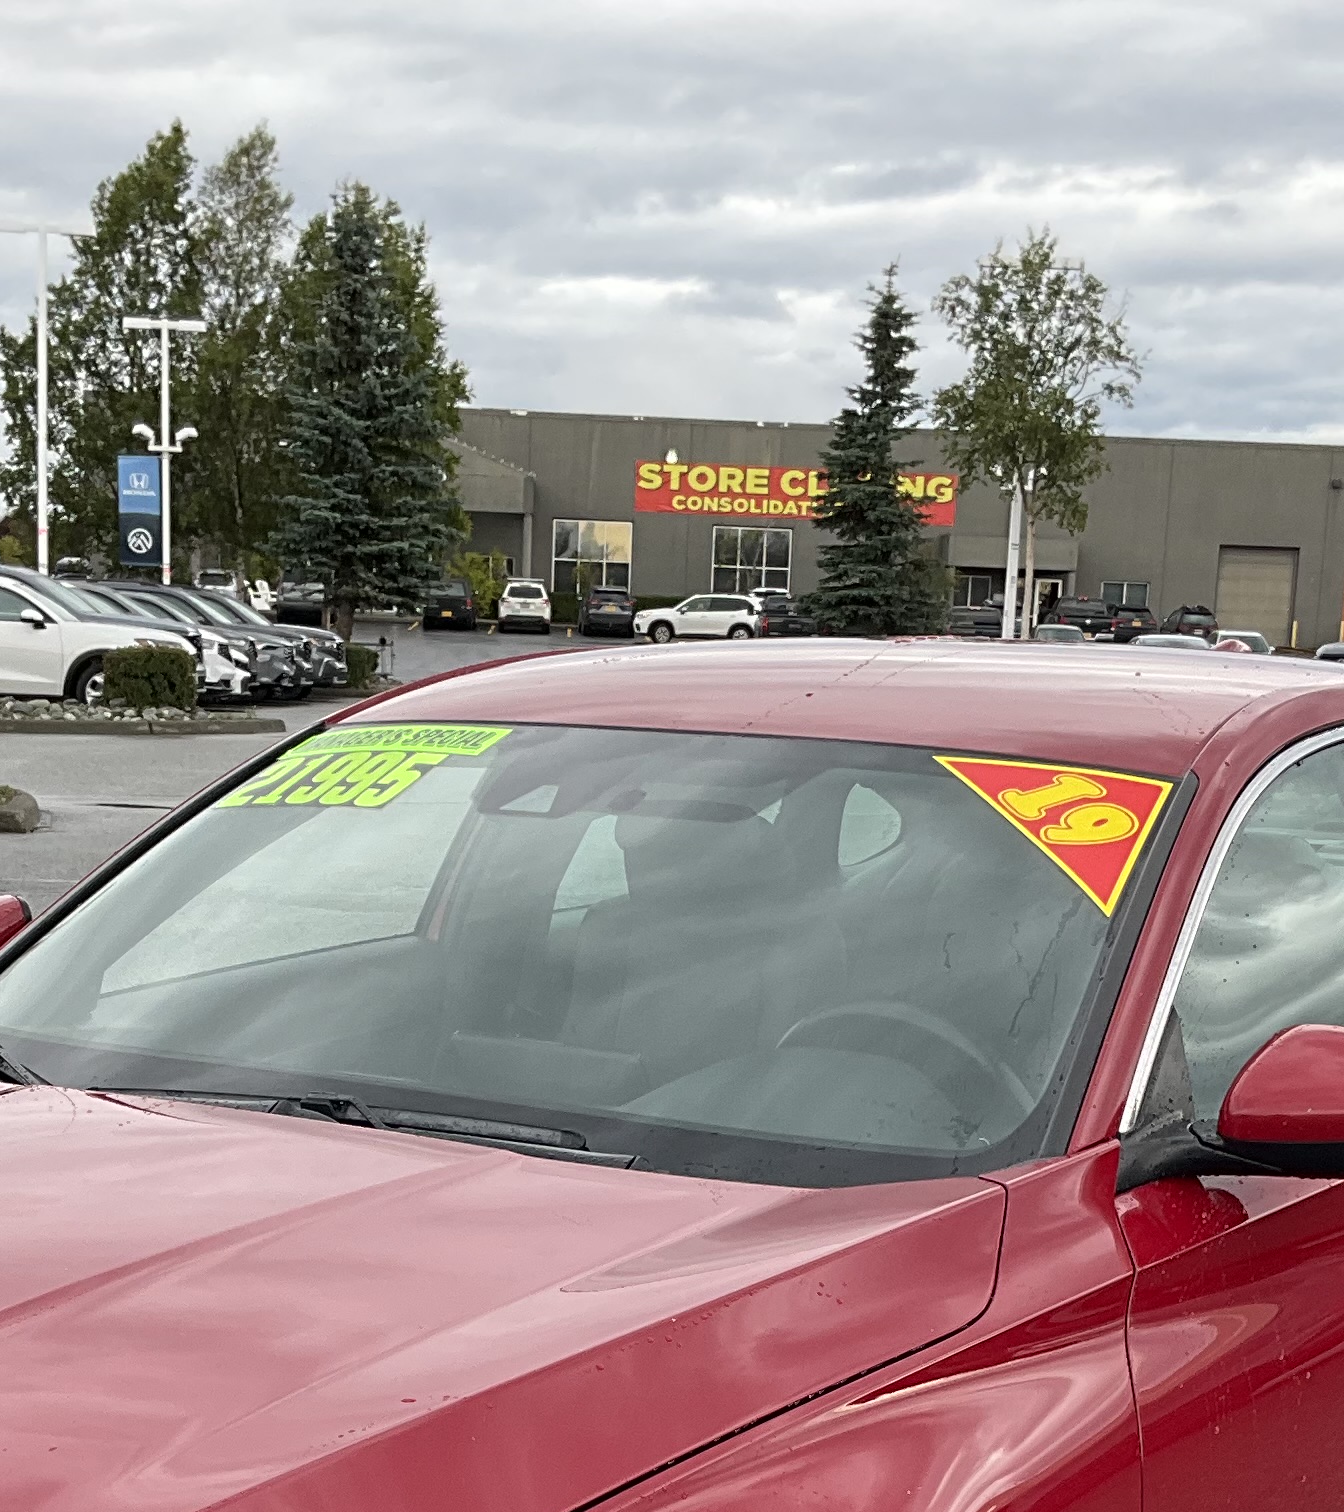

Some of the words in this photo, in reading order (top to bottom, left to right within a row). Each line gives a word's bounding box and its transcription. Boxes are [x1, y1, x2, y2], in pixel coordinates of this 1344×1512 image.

[637, 462, 770, 495] STORE
[779, 469, 954, 503] CLNG
[401, 729, 497, 749] SPECIAL
[216, 751, 449, 808] 21995
[998, 774, 1140, 845] 19
